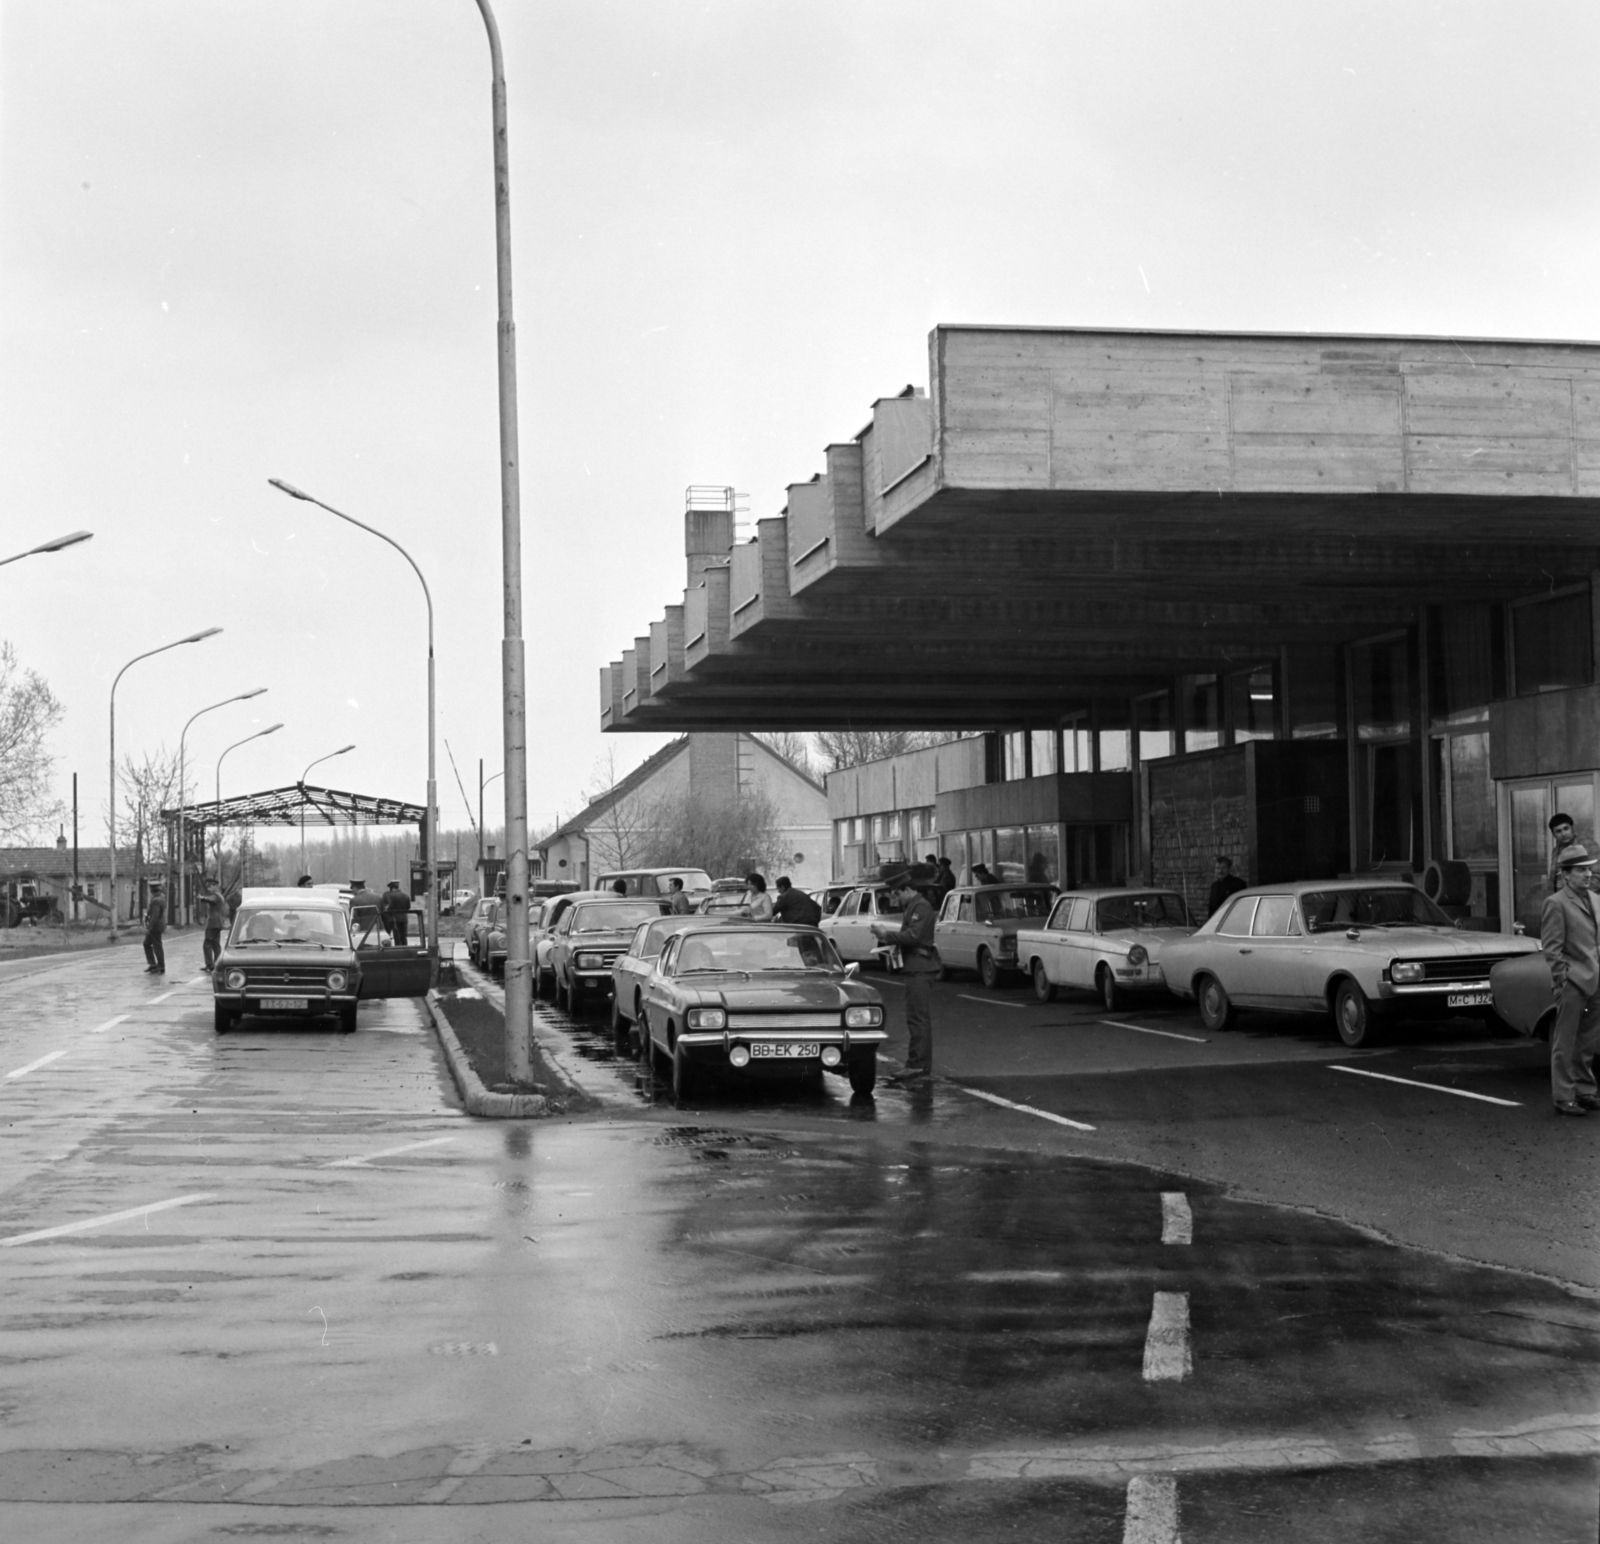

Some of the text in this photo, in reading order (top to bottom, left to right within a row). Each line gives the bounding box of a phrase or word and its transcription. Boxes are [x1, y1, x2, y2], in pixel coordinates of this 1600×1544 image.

[1449, 995, 1469, 1006] M-C
[752, 1044, 818, 1056] BB-EK 250
